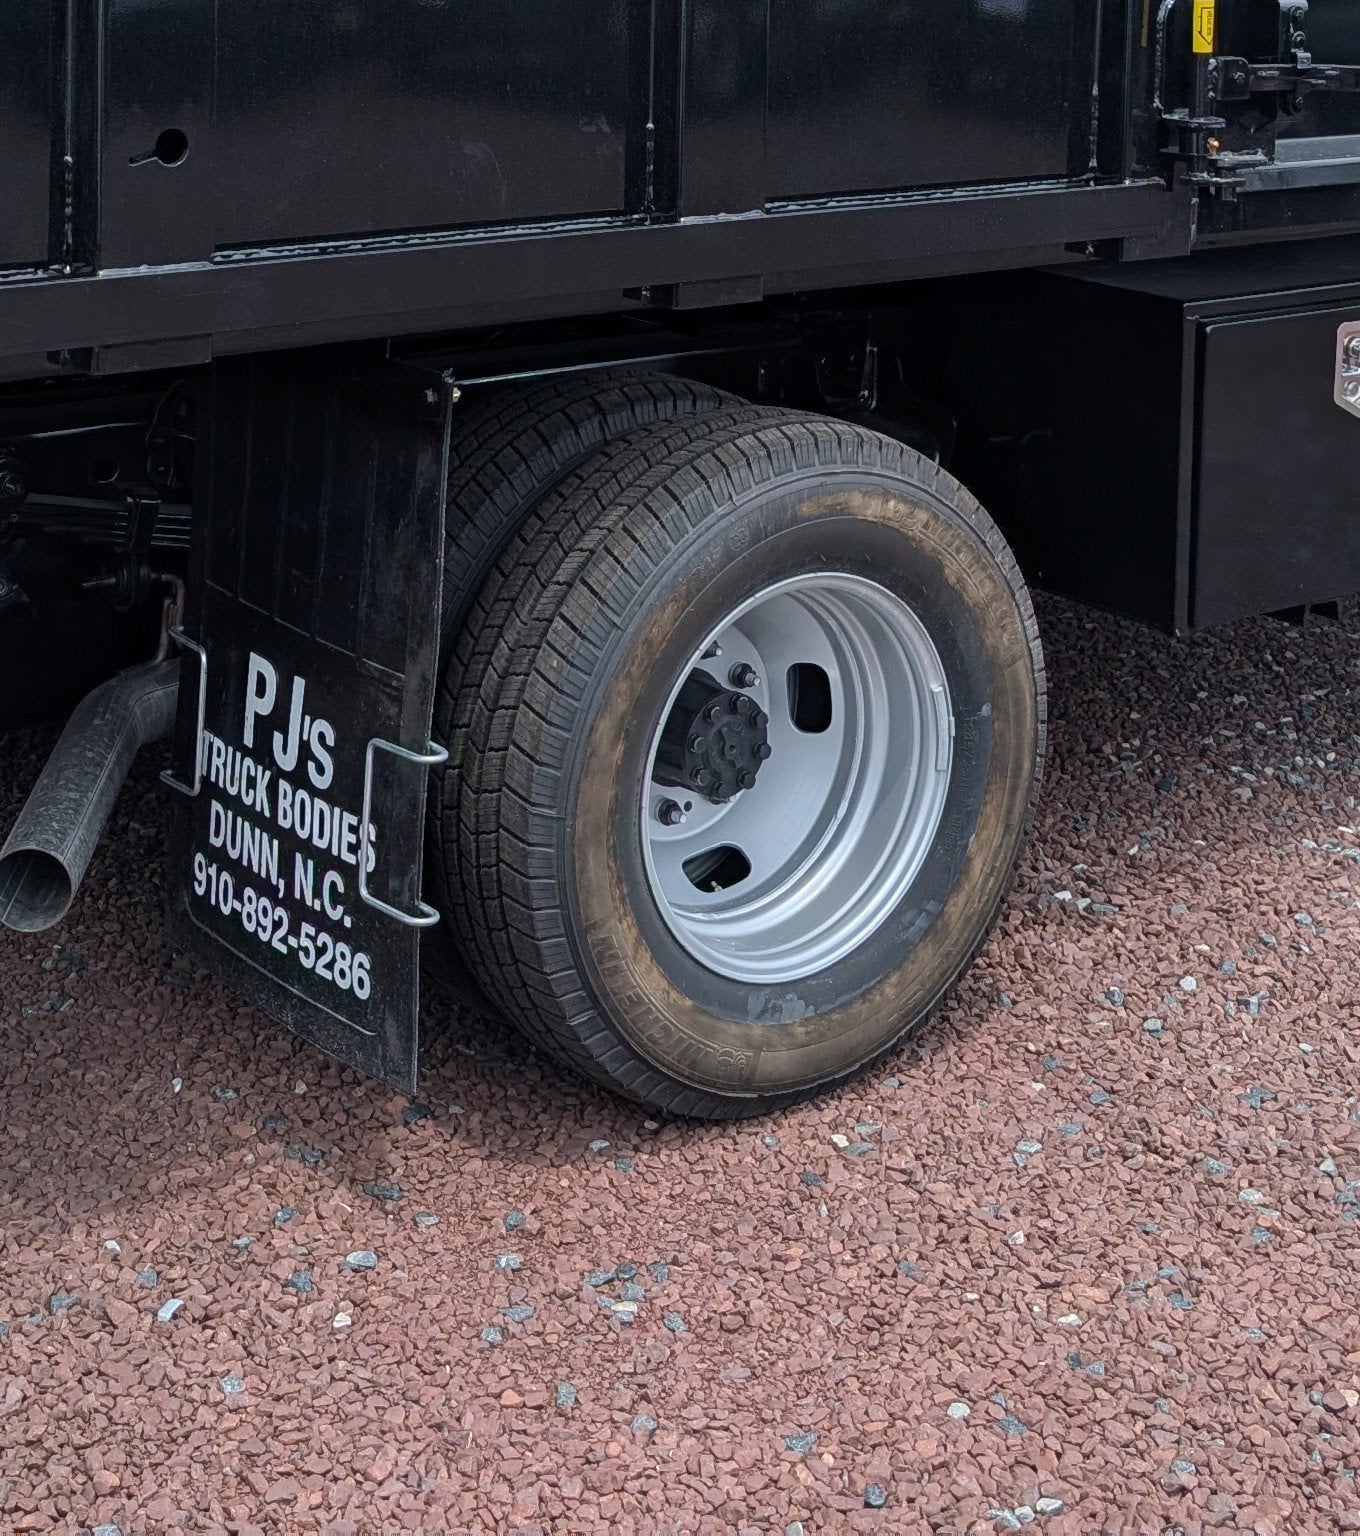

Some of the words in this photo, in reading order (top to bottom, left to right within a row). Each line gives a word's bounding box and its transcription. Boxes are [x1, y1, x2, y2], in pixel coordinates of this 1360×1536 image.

[244, 651, 335, 790] PJ'S
[202, 729, 271, 818] TRUCK
[278, 780, 377, 872] BODIES
[210, 800, 285, 898] DUNN,
[294, 858, 353, 927] N.C.
[193, 852, 371, 1001] 910-892-5286
